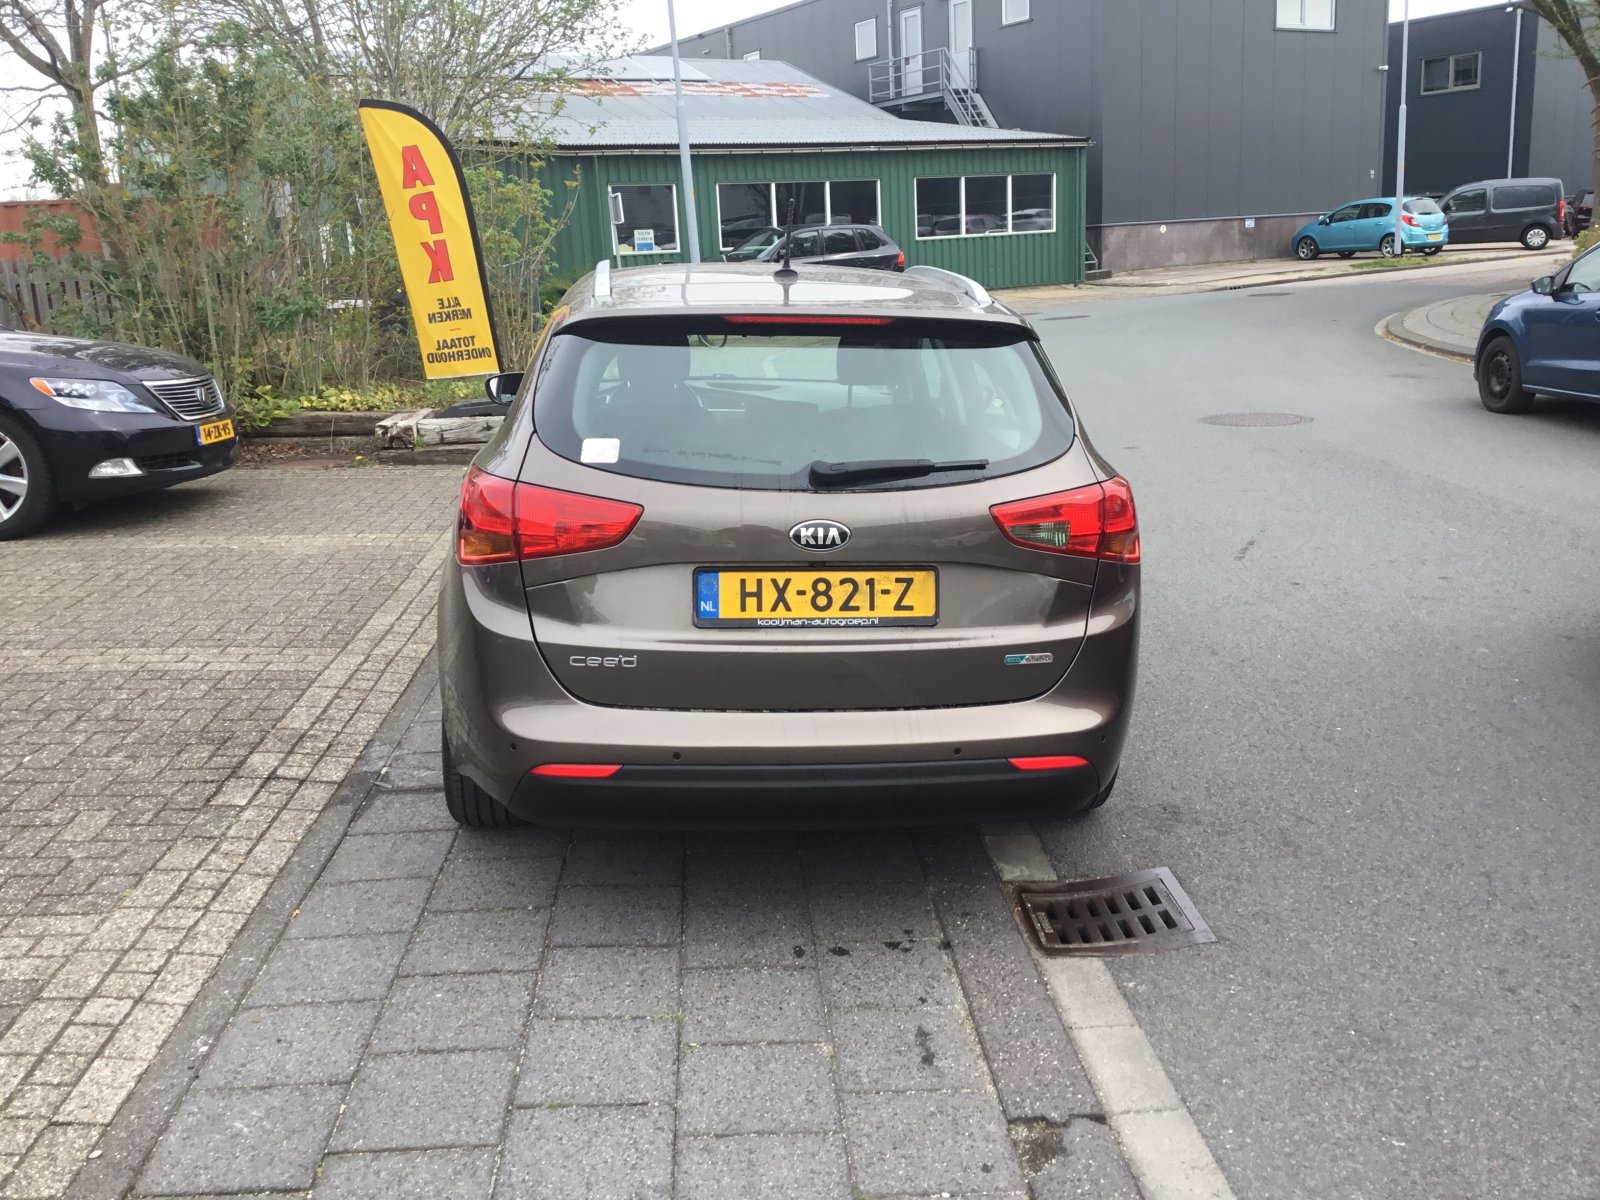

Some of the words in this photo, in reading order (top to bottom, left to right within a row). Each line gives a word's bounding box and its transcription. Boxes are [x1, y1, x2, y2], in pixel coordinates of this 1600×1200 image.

[800, 528, 842, 545] KIA
[739, 577, 915, 612] HX-821-Z
[700, 601, 717, 612] NL
